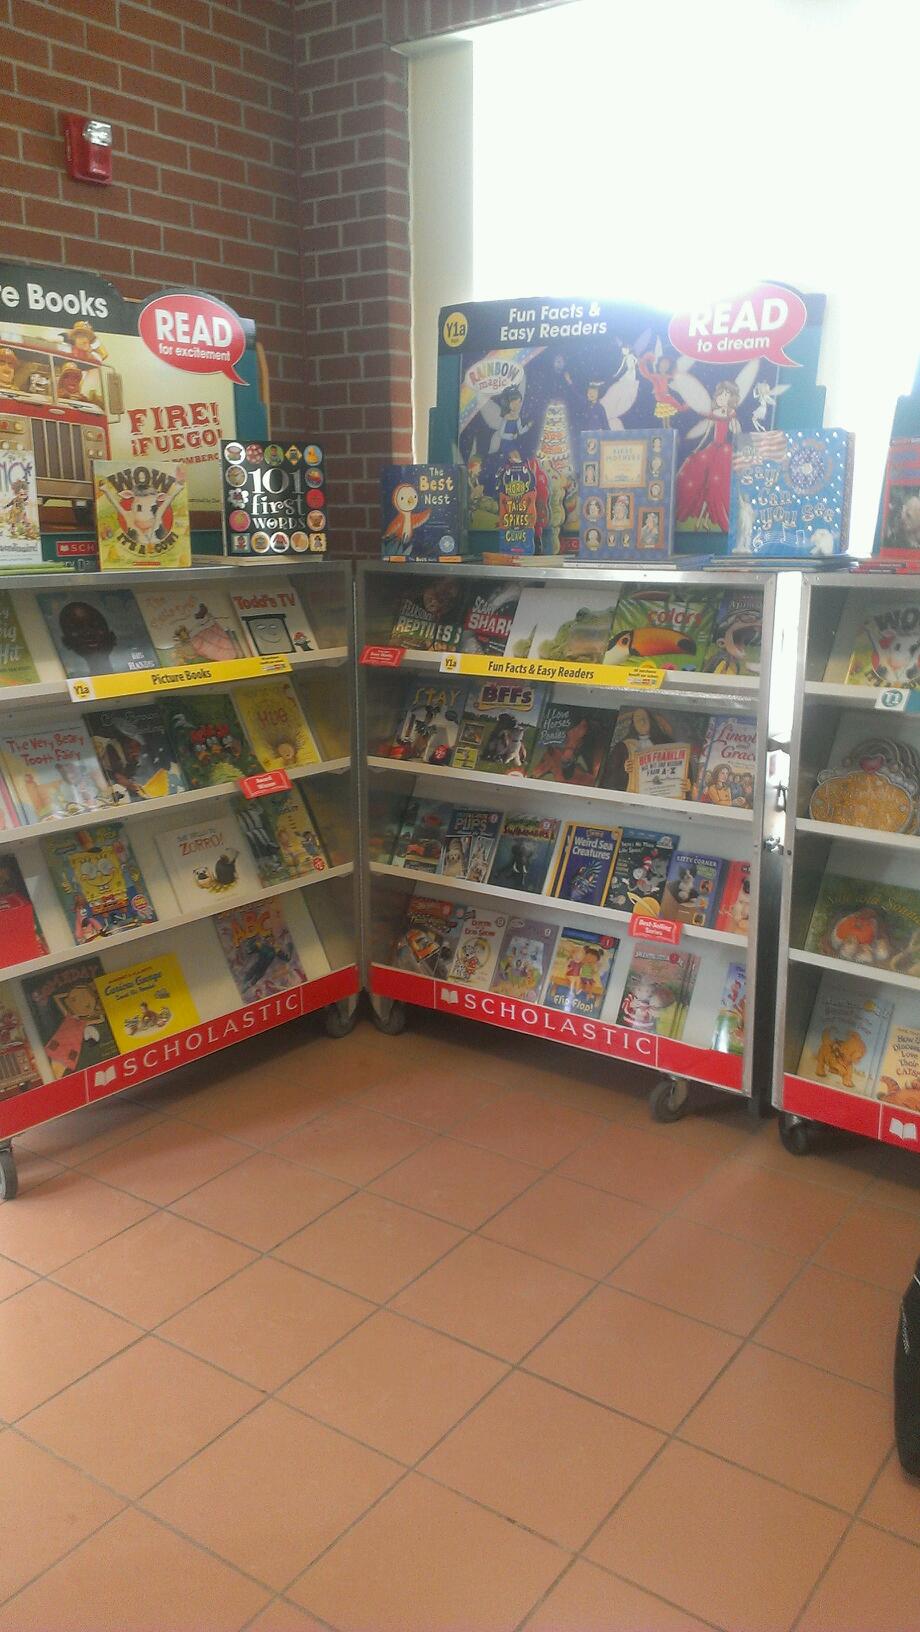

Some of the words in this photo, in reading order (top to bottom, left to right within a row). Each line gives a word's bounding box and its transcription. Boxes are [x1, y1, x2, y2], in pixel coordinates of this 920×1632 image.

[26, 282, 109, 319] Books
[509, 308, 536, 324] Fun
[541, 304, 584, 320] Facts
[588, 302, 601, 317] &
[688, 297, 789, 338] READ
[154, 308, 233, 349] READ
[446, 321, 467, 339] Y1a
[501, 325, 536, 343] Easy
[539, 321, 608, 338] Readers
[159, 343, 174, 355] for
[176, 347, 231, 362] excitement
[697, 339, 713, 353] to
[717, 335, 770, 351] dream
[468, 360, 520, 386] RAINBOW
[478, 374, 508, 391] magic
[127, 401, 221, 435] FIRE!
[103, 466, 176, 494] WOW
[247, 467, 305, 495] 101
[429, 467, 445, 477] The
[418, 474, 455, 492] Best
[251, 493, 306, 516] first
[424, 494, 452, 505] Nest
[277, 592, 297, 607] TV
[396, 615, 455, 642] REPTILES
[151, 670, 186, 686] Picture
[185, 667, 213, 682] Books
[488, 661, 504, 672] Fun
[505, 662, 527, 674] Facts
[528, 663, 536, 674] &
[537, 664, 557, 679] Easy
[558, 666, 594, 680] Readers
[482, 685, 533, 705] BFFs
[543, 718, 571, 730] Horses
[551, 709, 570, 720] Love
[30, 738, 54, 751] Very
[20, 751, 54, 767] Tooth
[572, 846, 611, 860] Creatures
[574, 836, 598, 849] Weird
[599, 840, 614, 851] Sea
[694, 858, 717, 867] CORNER
[553, 994, 569, 1006] Flip
[572, 998, 594, 1013] Flop!
[463, 993, 652, 1055] SCHOLASTIC
[121, 993, 300, 1078] SCHOLASTIC
